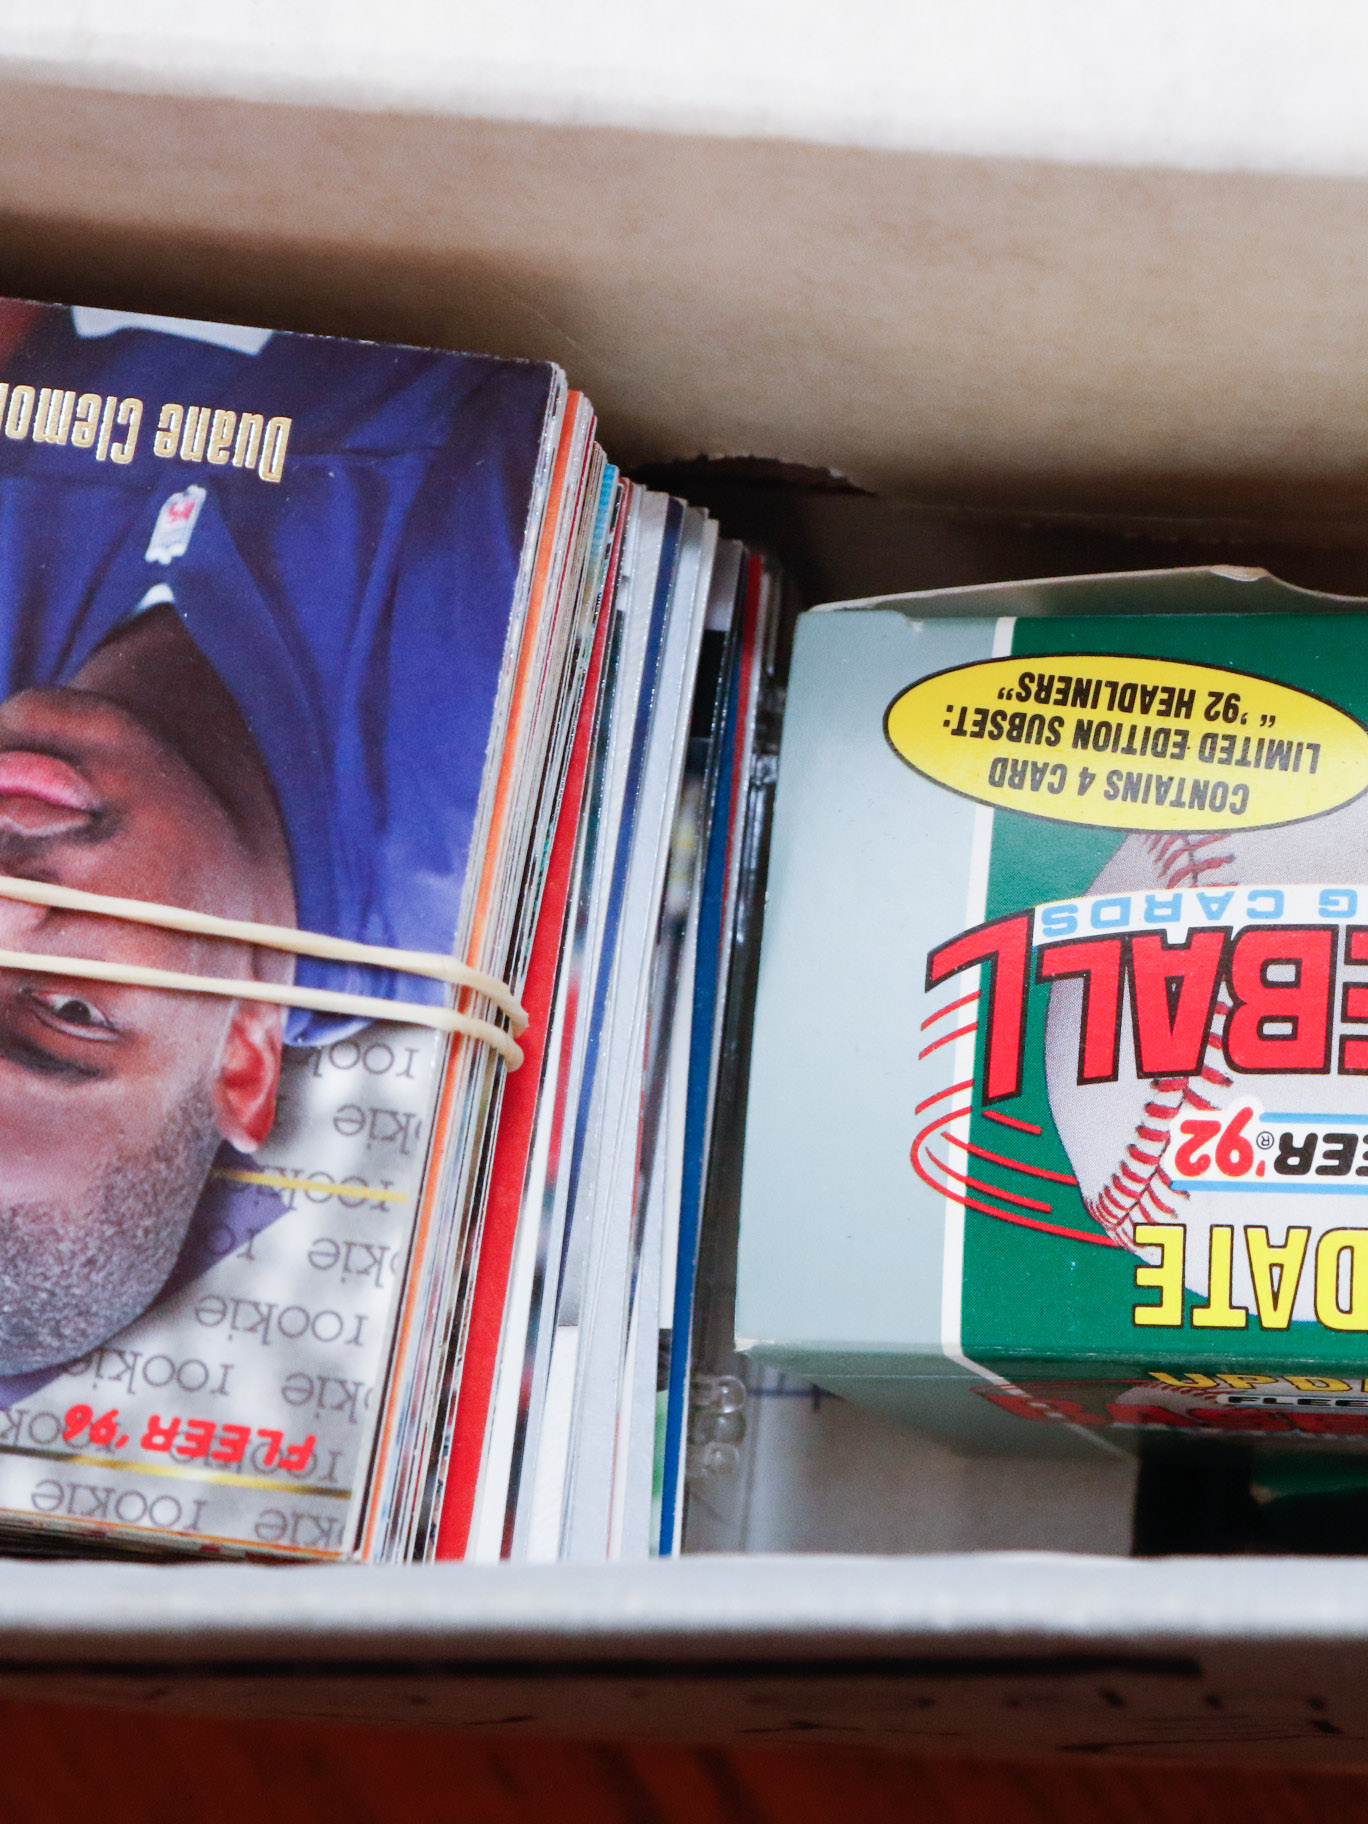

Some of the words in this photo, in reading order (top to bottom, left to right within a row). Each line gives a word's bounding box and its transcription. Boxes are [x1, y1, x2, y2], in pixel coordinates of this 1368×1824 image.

[153, 402, 293, 483] Duane
[997, 670, 1197, 720] HEADLINERS"
[943, 703, 1067, 748] SUBSET:
[1071, 718, 1190, 760] EDITION
[988, 755, 1068, 796] CARD
[1199, 733, 1322, 775] LIMITED
[1079, 766, 1096, 796] 4
[1104, 769, 1250, 815] CONTAINS
[1041, 887, 1286, 939] CARDS
[333, 1103, 423, 1156] kie
[308, 1237, 401, 1288] kie
[194, 1294, 370, 1347] rookie
[281, 1371, 375, 1425] kie
[61, 1403, 130, 1450] '96
[140, 1414, 318, 1474] FLEER
[30, 1478, 208, 1533] rookie
